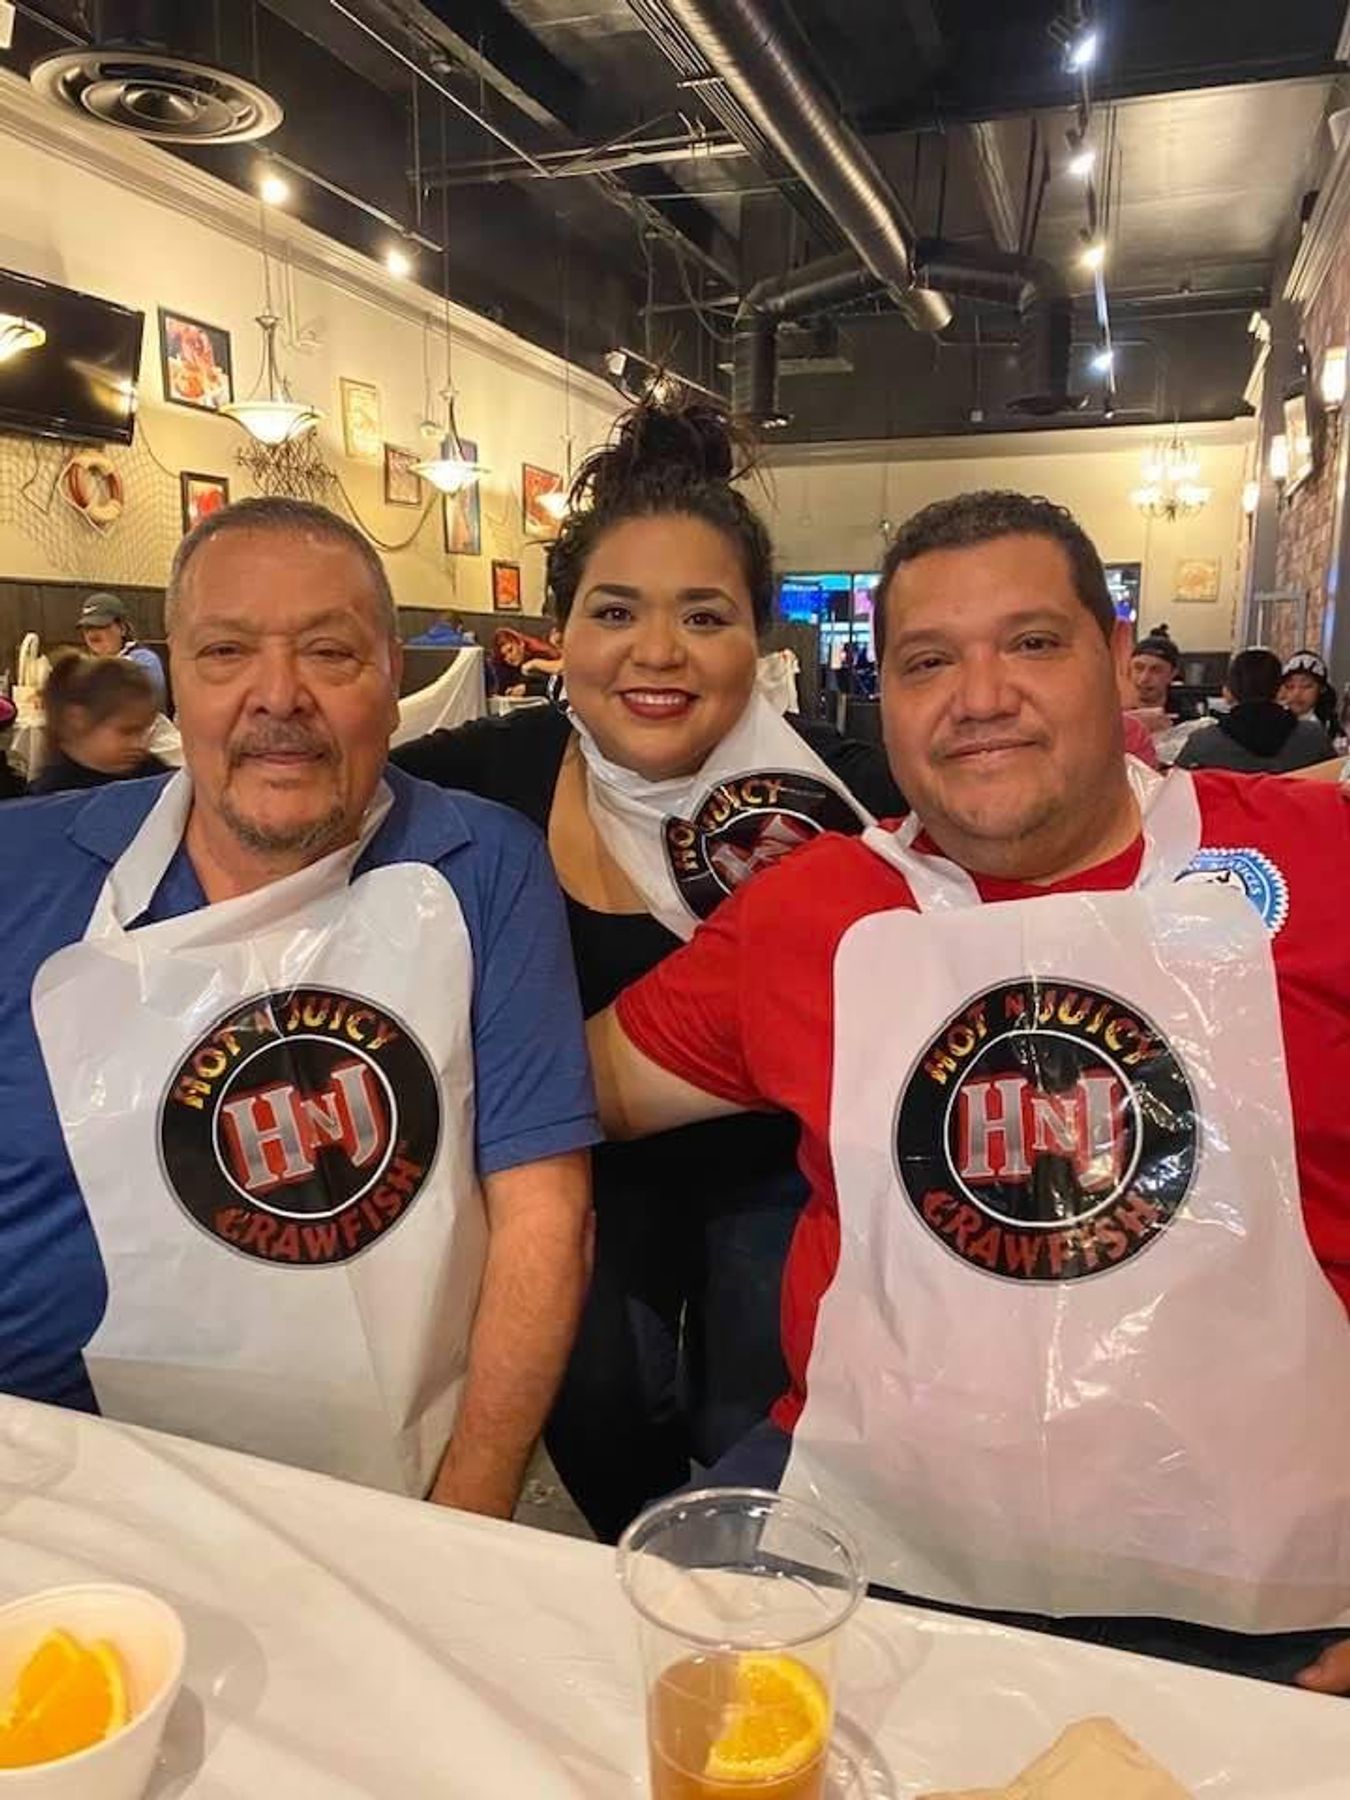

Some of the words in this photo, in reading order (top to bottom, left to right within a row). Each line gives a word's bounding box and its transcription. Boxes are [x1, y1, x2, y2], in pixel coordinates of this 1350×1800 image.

[668, 824, 698, 872] HO
[703, 779, 782, 831] JUICY
[174, 1026, 242, 1110] HOT
[287, 996, 397, 1050] JUICY
[924, 1003, 989, 1085] HOT
[1039, 990, 1162, 1064] JUICY
[213, 1155, 423, 1260] CRAWFISH
[922, 1188, 1162, 1275] CRAWFISH
